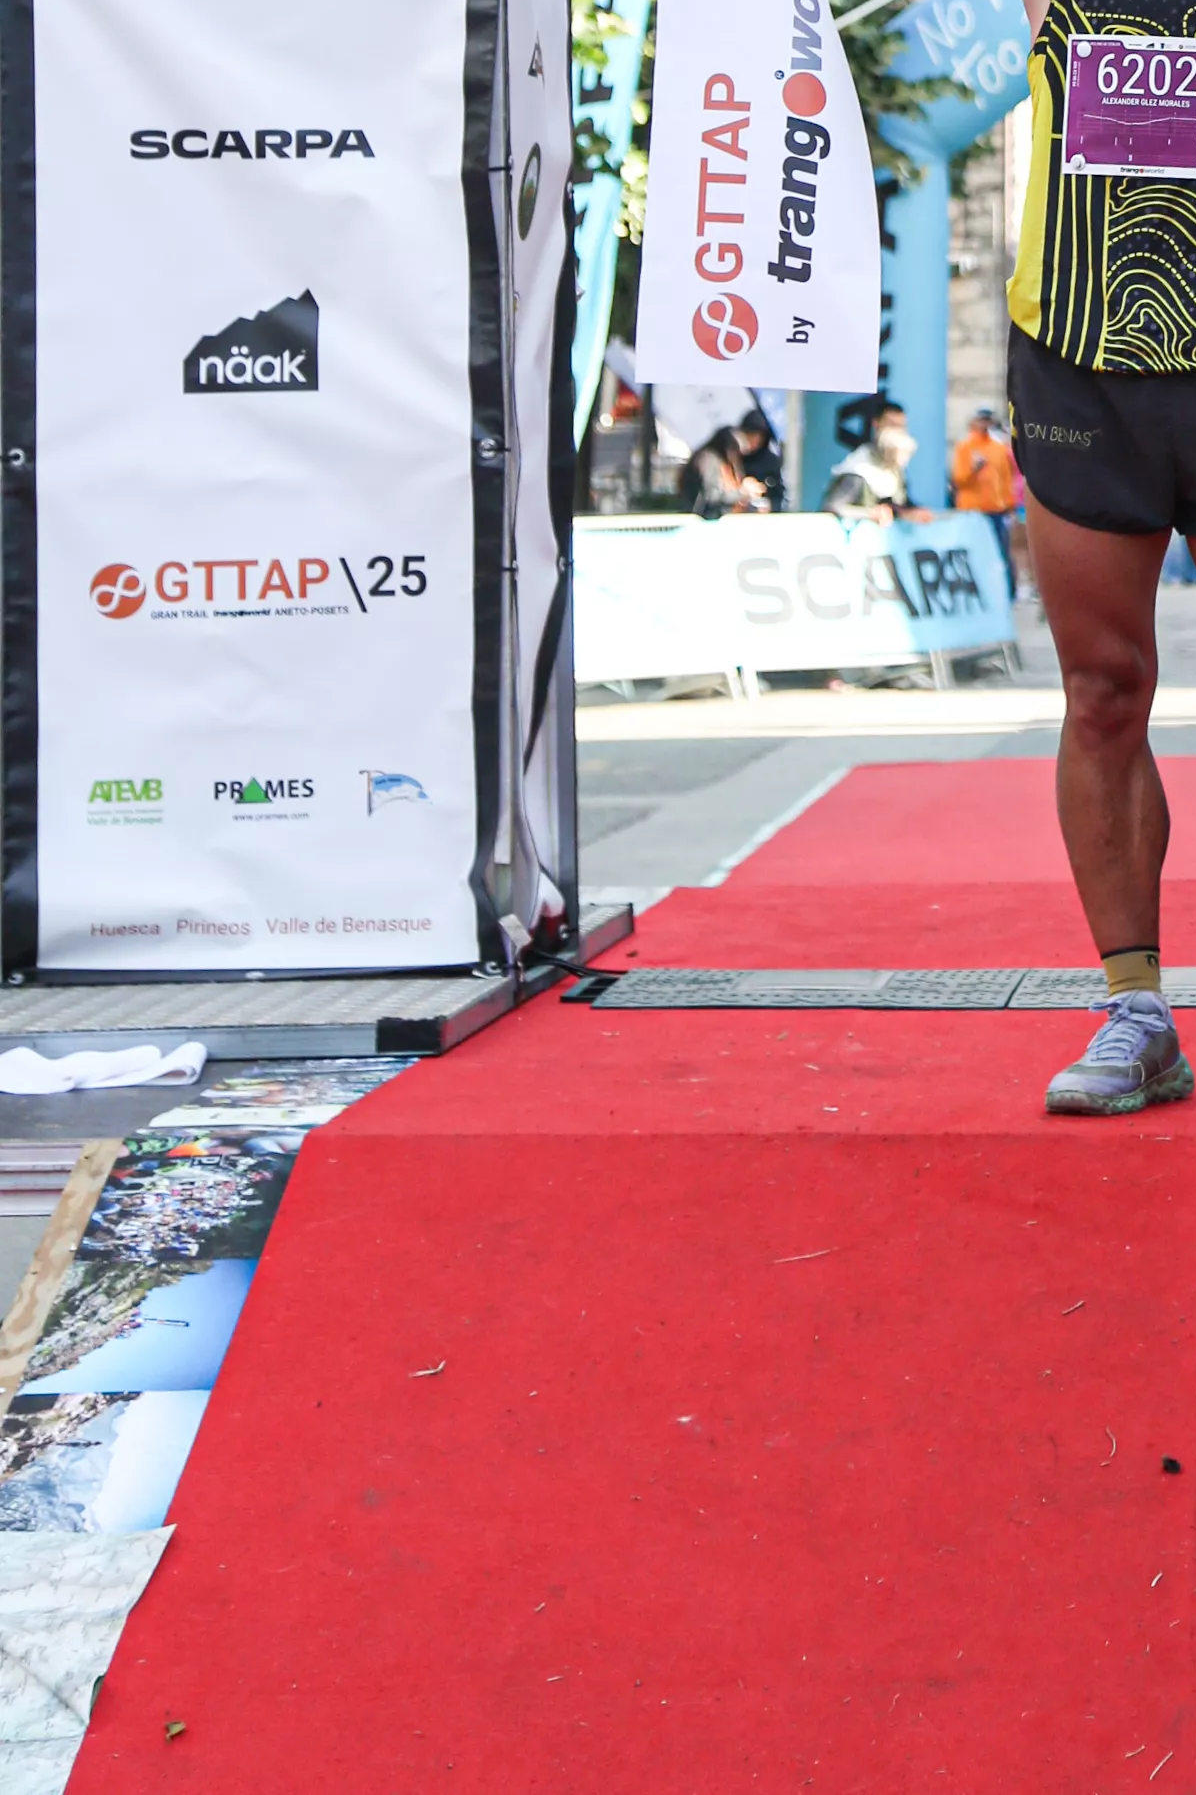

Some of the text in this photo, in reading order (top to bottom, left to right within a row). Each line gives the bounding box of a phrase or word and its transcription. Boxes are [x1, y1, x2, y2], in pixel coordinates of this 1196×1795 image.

[1102, 97, 1139, 107] ALEXANDER
[1159, 99, 1190, 109] MORALES
[130, 128, 375, 159] SCARPA
[694, 72, 751, 282] GTTAP
[786, 316, 815, 344] by
[198, 346, 307, 385] näak
[155, 558, 329, 603] GTTAP
[150, 610, 178, 620] GRAN
[182, 610, 208, 618] TRAIL
[274, 606, 349, 616] ANETO-POSETS
[90, 916, 432, 937] Huesca Pirineos Valle de Benasque
